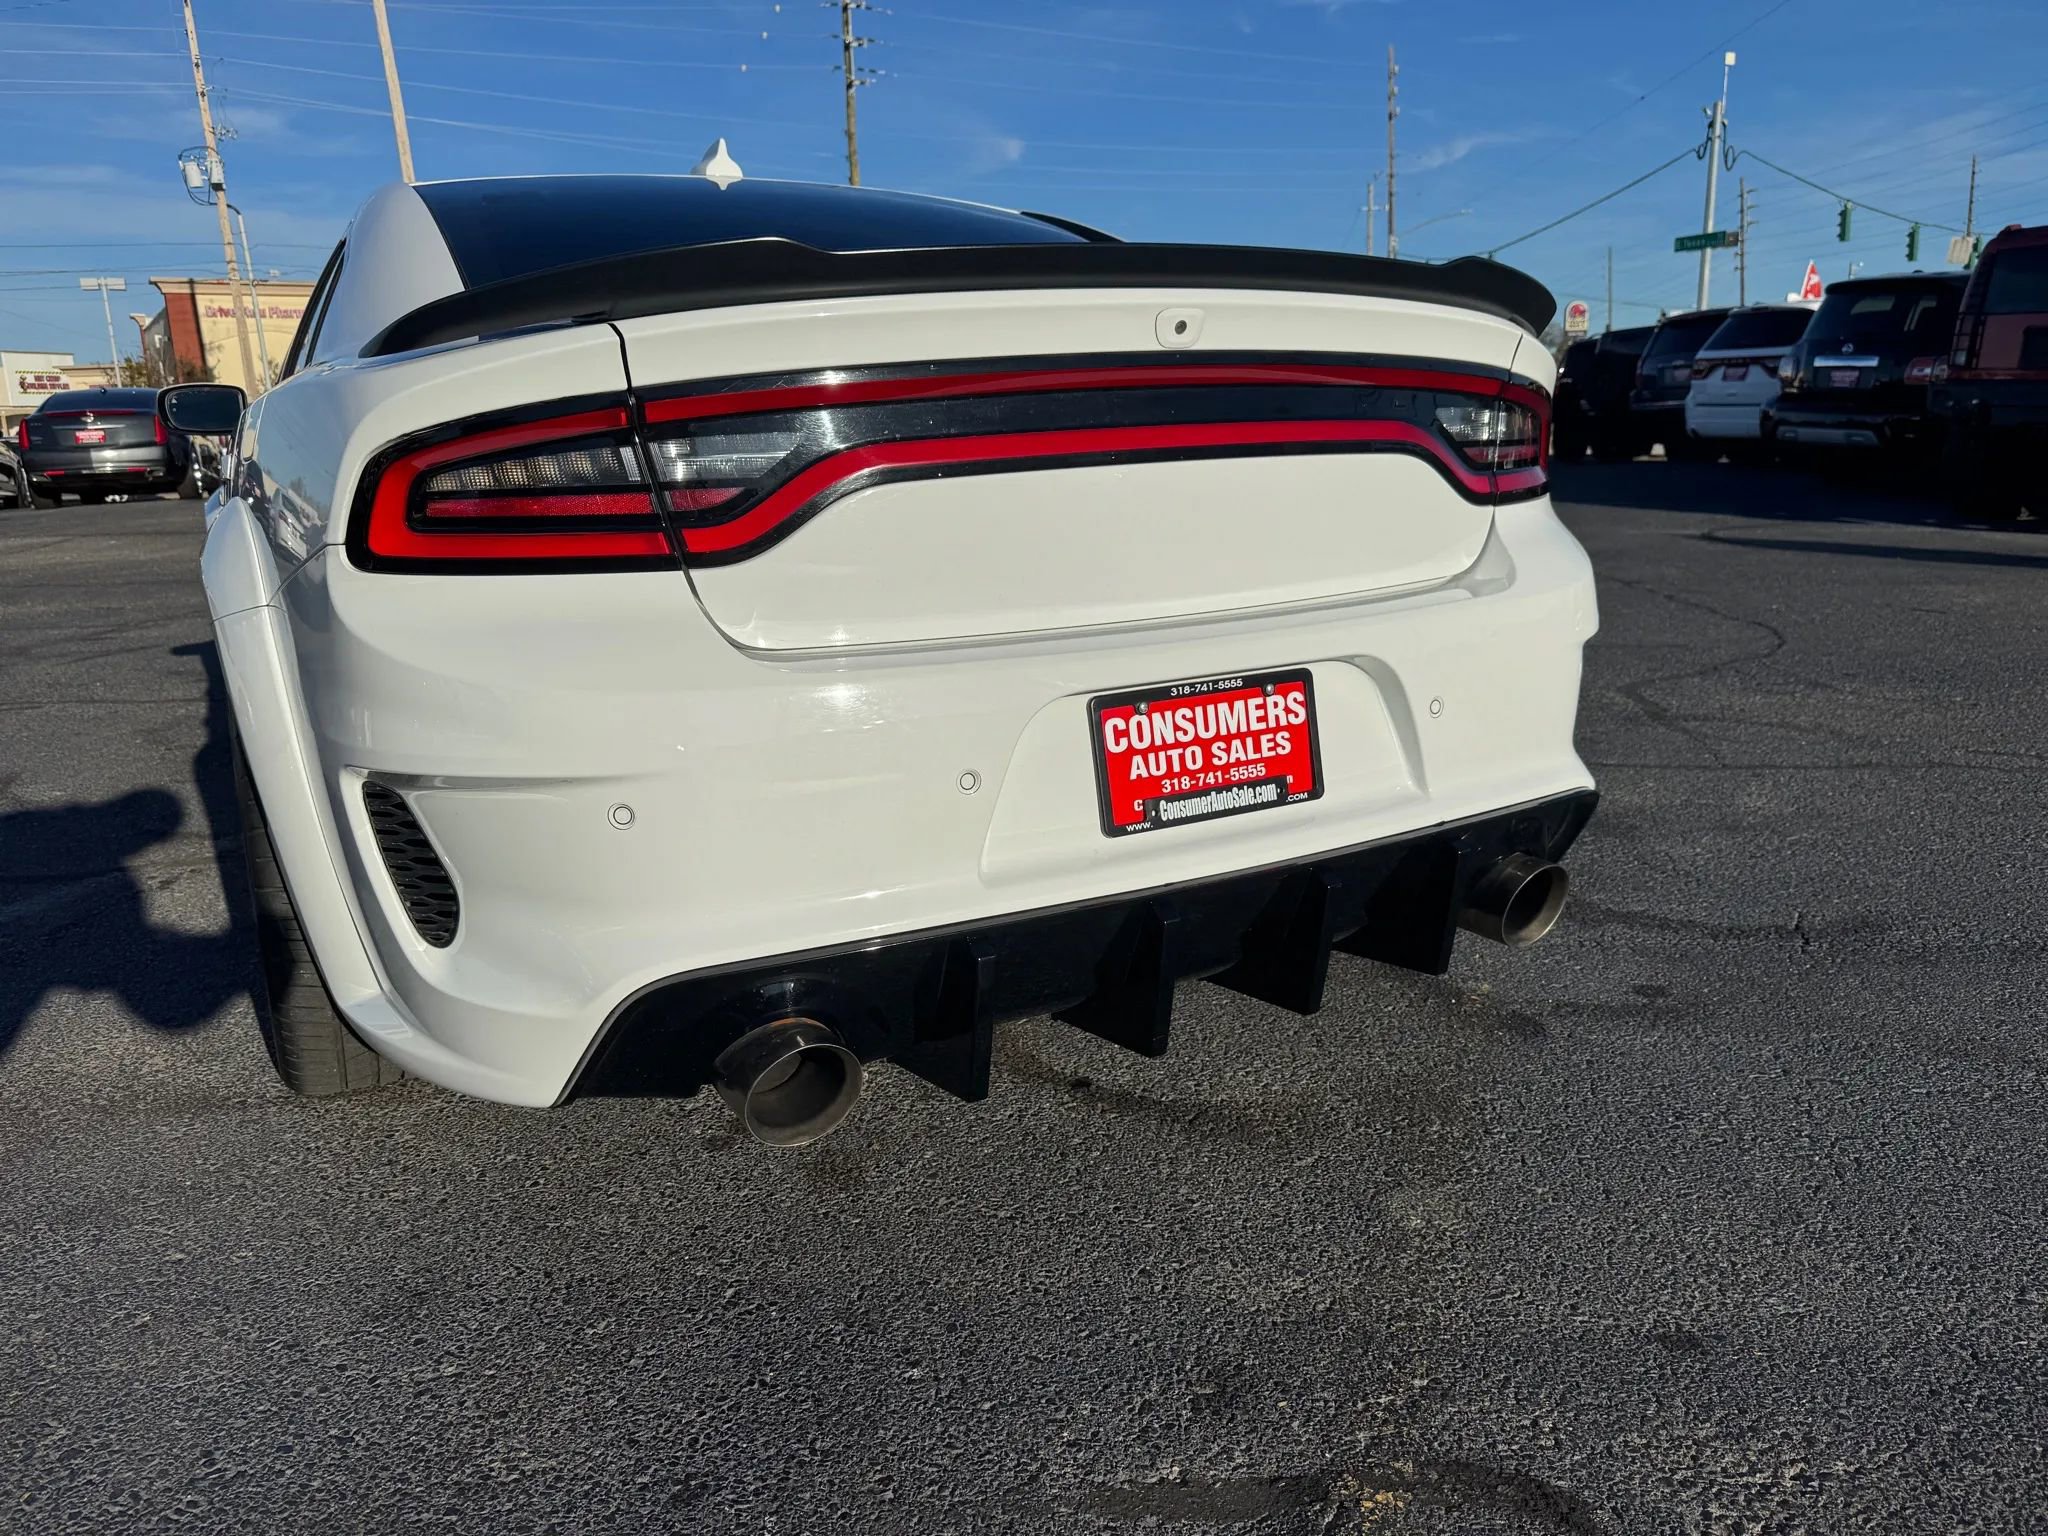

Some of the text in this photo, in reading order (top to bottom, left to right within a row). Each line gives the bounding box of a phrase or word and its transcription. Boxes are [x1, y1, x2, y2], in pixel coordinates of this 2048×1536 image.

[1170, 678, 1244, 696] 318-741-5555
[1104, 691, 1307, 753] CONSUMERS
[1129, 731, 1292, 780] AUTO SALES
[1161, 763, 1266, 793] 318-741-5555
[1159, 783, 1278, 822] ConsumerAutoSale.com
[1126, 822, 1154, 832] www.
